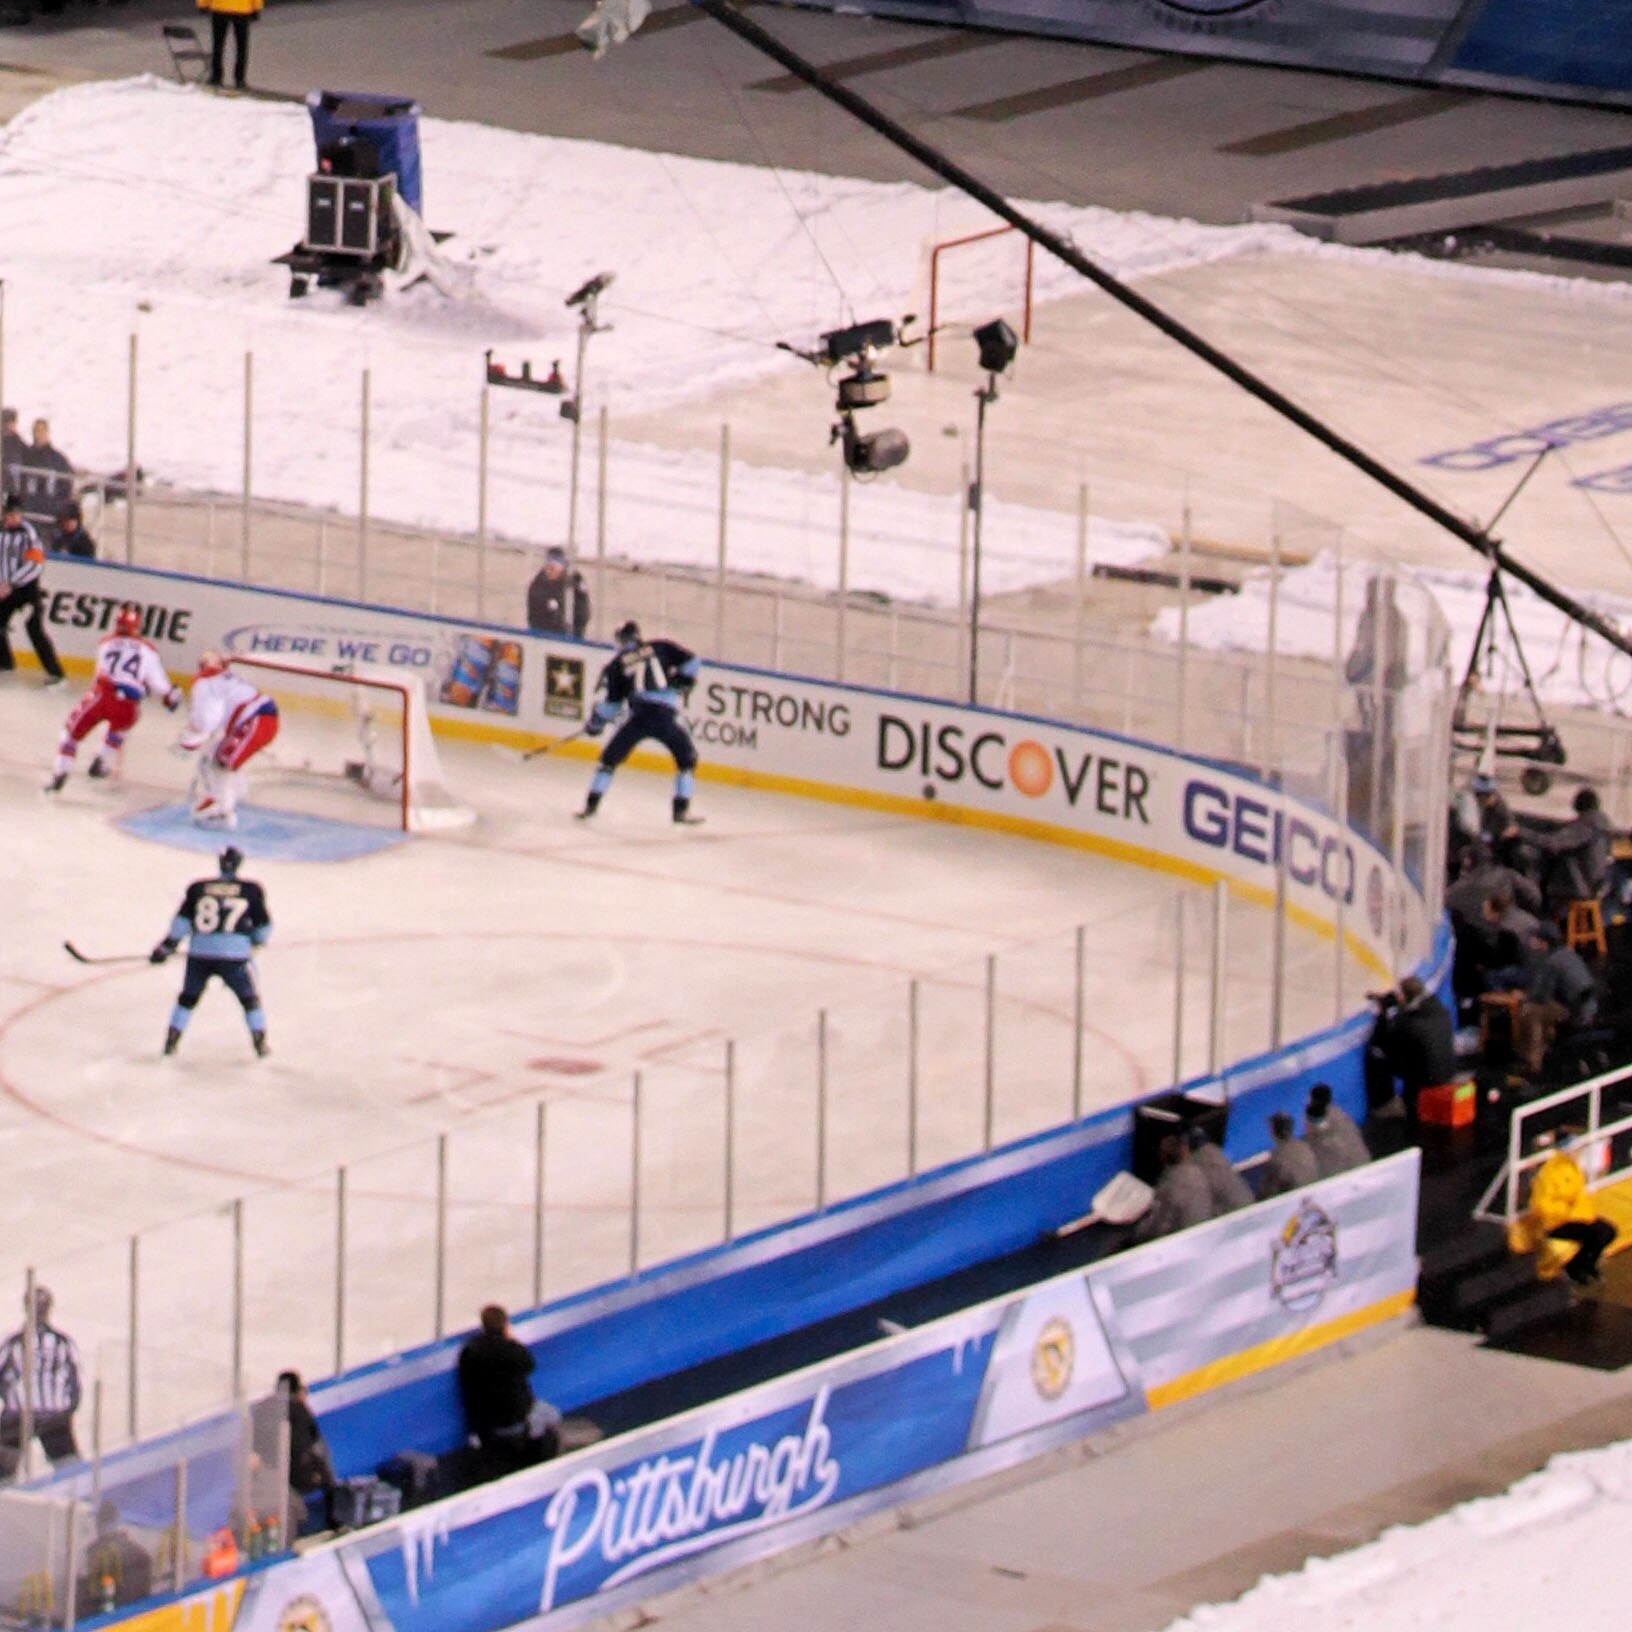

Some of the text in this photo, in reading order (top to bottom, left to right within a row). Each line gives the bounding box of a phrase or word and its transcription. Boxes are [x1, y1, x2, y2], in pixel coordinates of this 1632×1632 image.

[105, 650, 142, 679] 74
[250, 631, 327, 656] HERE
[337, 638, 383, 664] WE
[388, 643, 433, 668] GO
[622, 654, 668, 694] 71
[706, 683, 852, 737] STRONG
[877, 713, 1152, 825] DISCOVER
[1183, 780, 1355, 905] GEICO
[194, 894, 250, 935] 87
[539, 1383, 841, 1614] Pittsburgh
